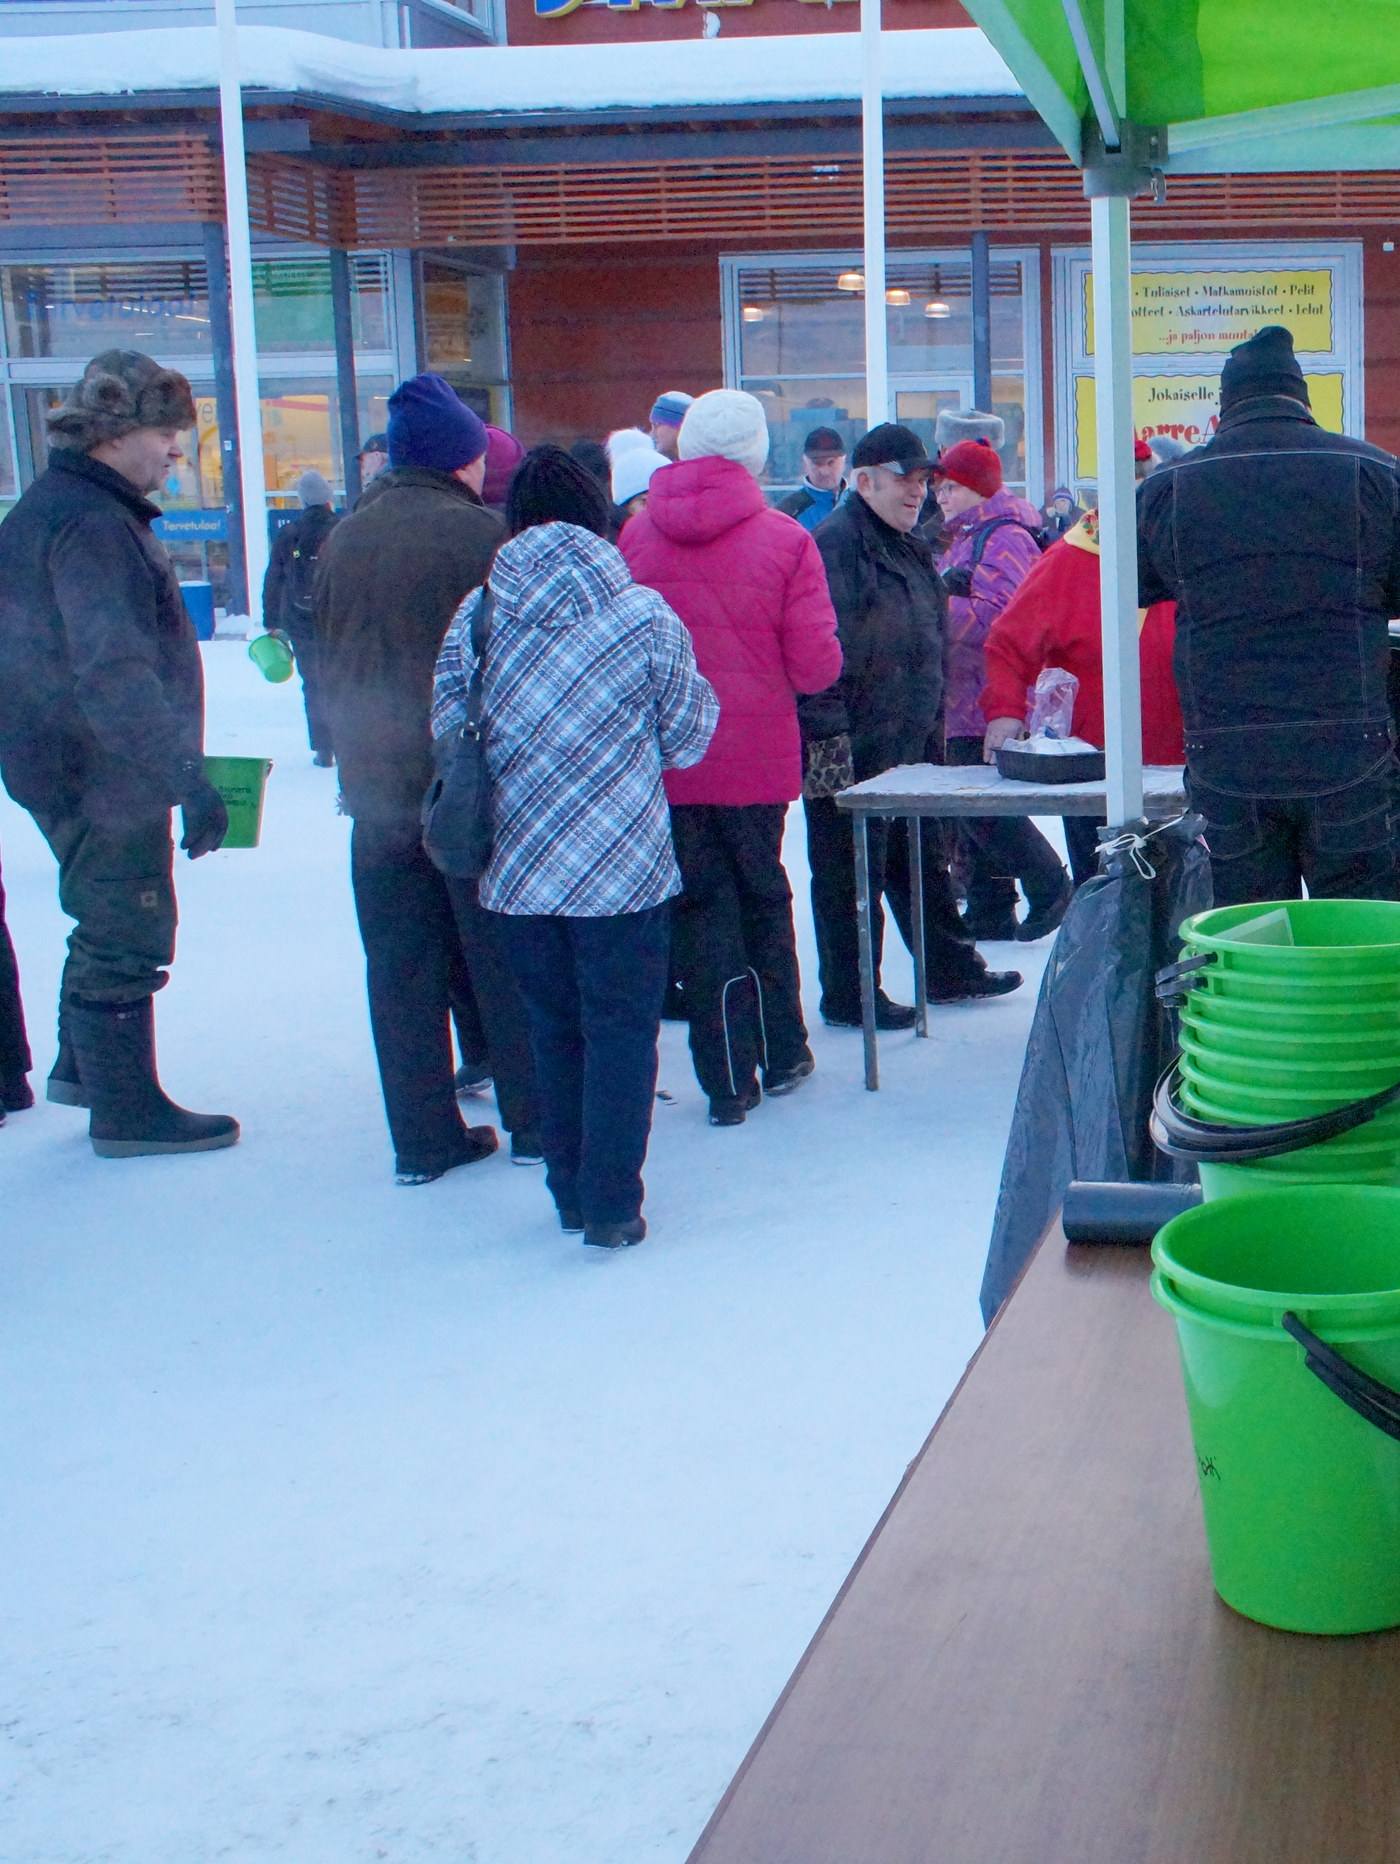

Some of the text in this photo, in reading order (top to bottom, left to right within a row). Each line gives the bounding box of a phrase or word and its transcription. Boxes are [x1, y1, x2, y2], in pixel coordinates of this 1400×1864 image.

[1143, 284, 1315, 297] Tuliaiset Matkamuistot Pelit
[1131, 304, 1323, 317] otteet Askartelutarvikkeet Lelut
[1181, 329, 1215, 345] paljon
[1148, 387, 1215, 403] Jokaiselle
[163, 519, 221, 532] Tervetuloa!
